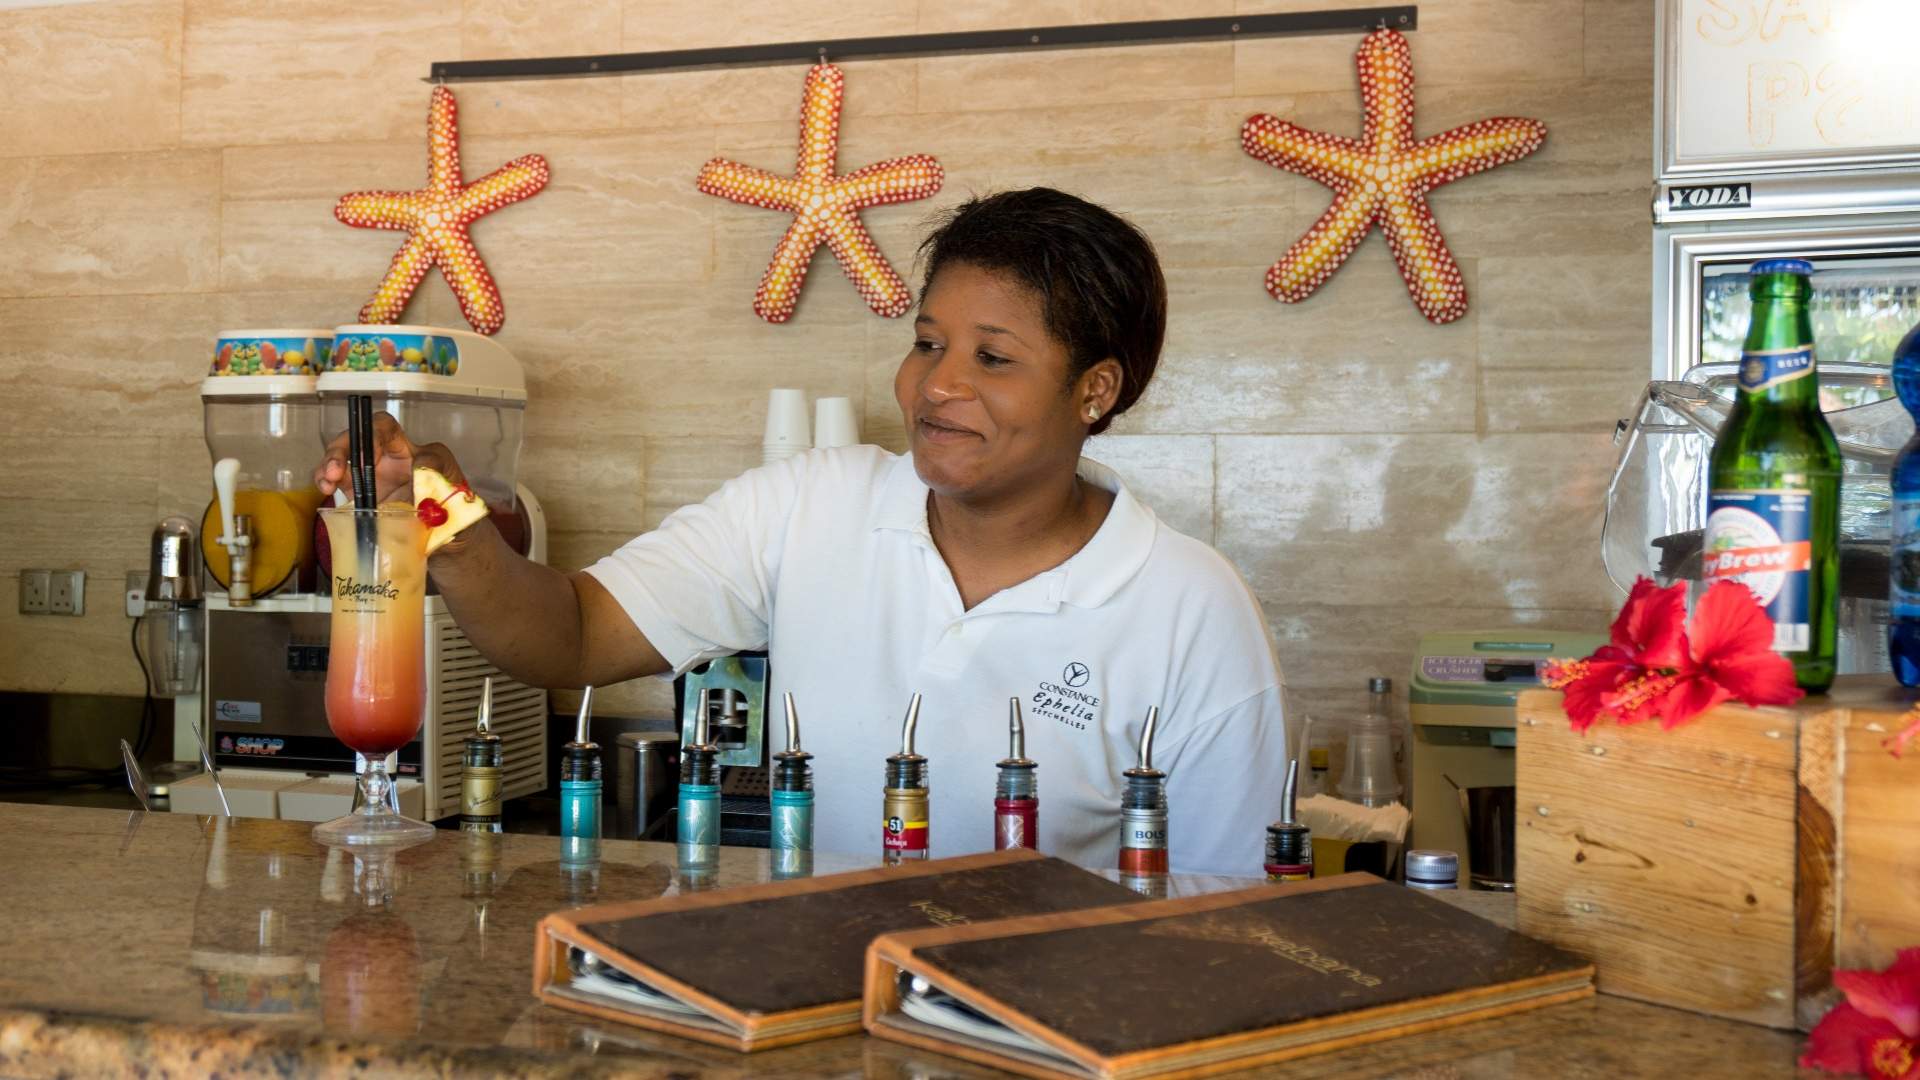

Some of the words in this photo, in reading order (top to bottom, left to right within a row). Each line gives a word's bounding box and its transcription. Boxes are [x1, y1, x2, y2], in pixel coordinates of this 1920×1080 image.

[1670, 185, 1751, 209] YODA
[335, 575, 399, 601] Takamaka
[1039, 681, 1100, 707] CONSTANCE
[1032, 691, 1094, 721] Ephelia
[1031, 707, 1086, 730] SEYCHELLES
[235, 736, 285, 756] SHOP
[890, 819, 901, 831] 51
[1135, 830, 1166, 840] BOLS
